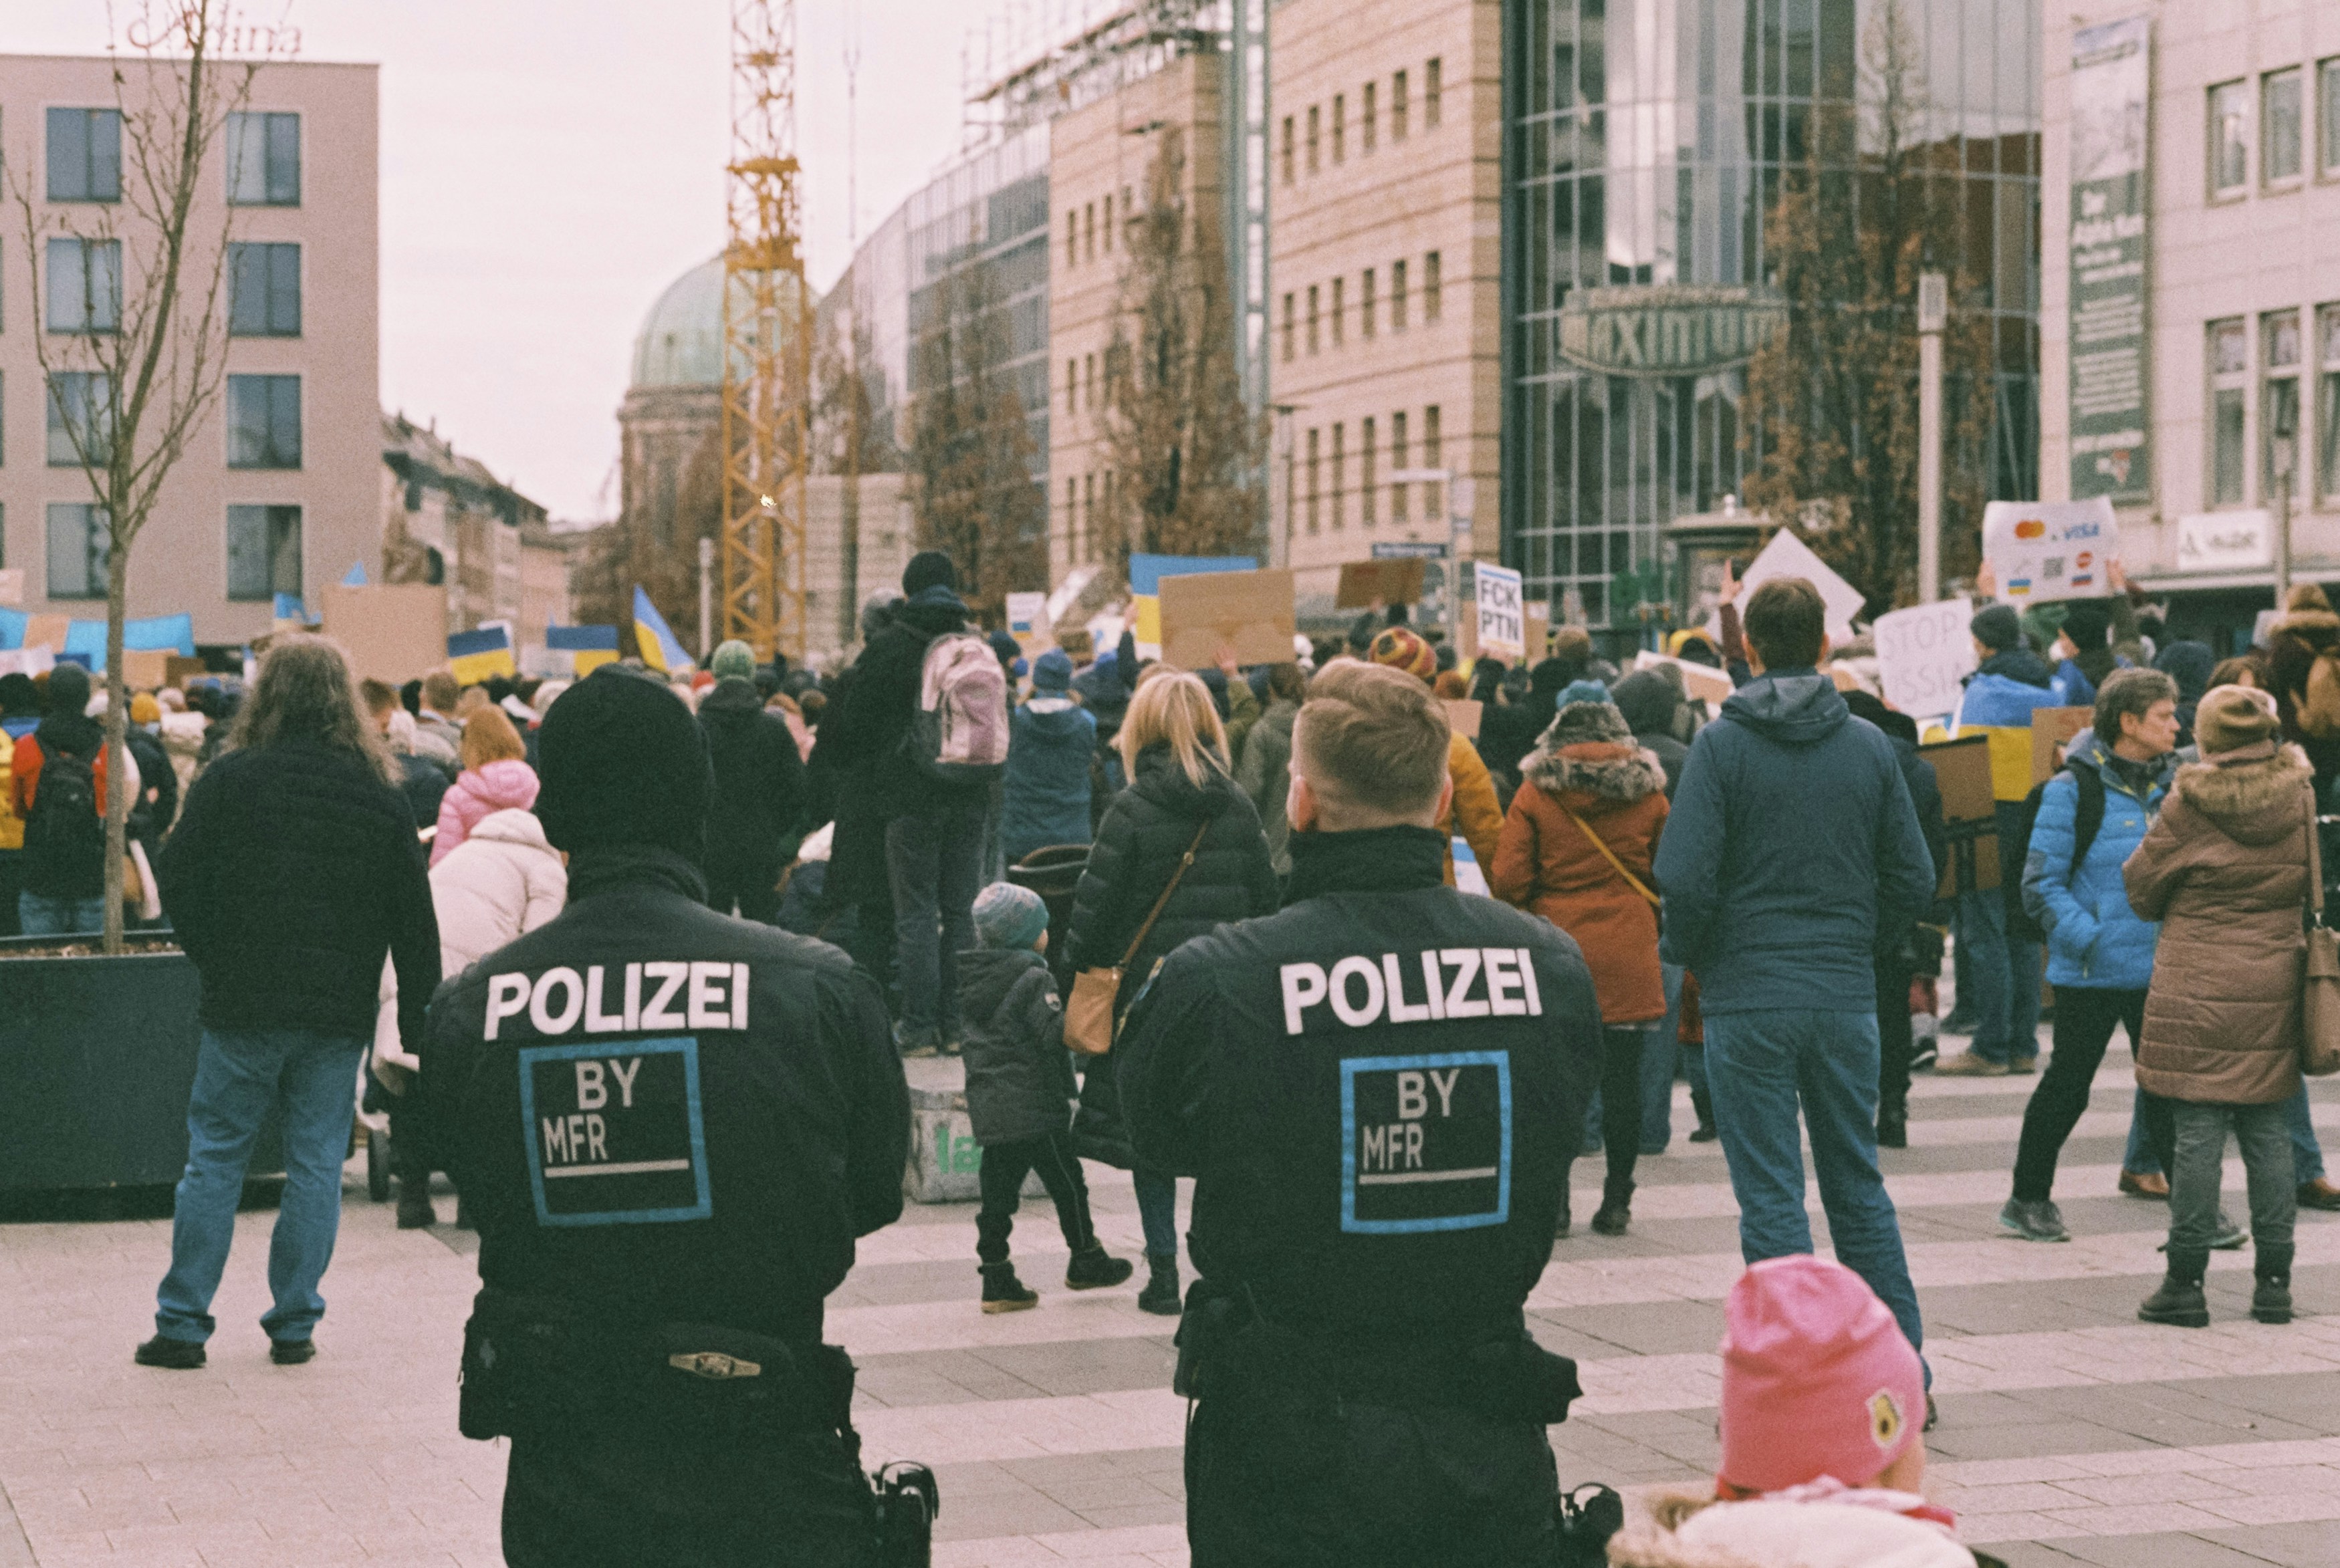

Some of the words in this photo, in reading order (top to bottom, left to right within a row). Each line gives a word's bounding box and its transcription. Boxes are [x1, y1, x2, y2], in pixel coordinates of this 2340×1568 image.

[1480, 579, 1518, 610] FCK
[1482, 610, 1519, 642] PTN
[1881, 610, 1959, 662] STOP
[483, 961, 750, 1041] POLIZEI
[1280, 948, 1543, 1035] POLIZEI
[574, 1057, 642, 1110] BY
[1397, 1067, 1460, 1120] BY
[542, 1113, 609, 1164] MFR
[1362, 1122, 1425, 1171] MFR
